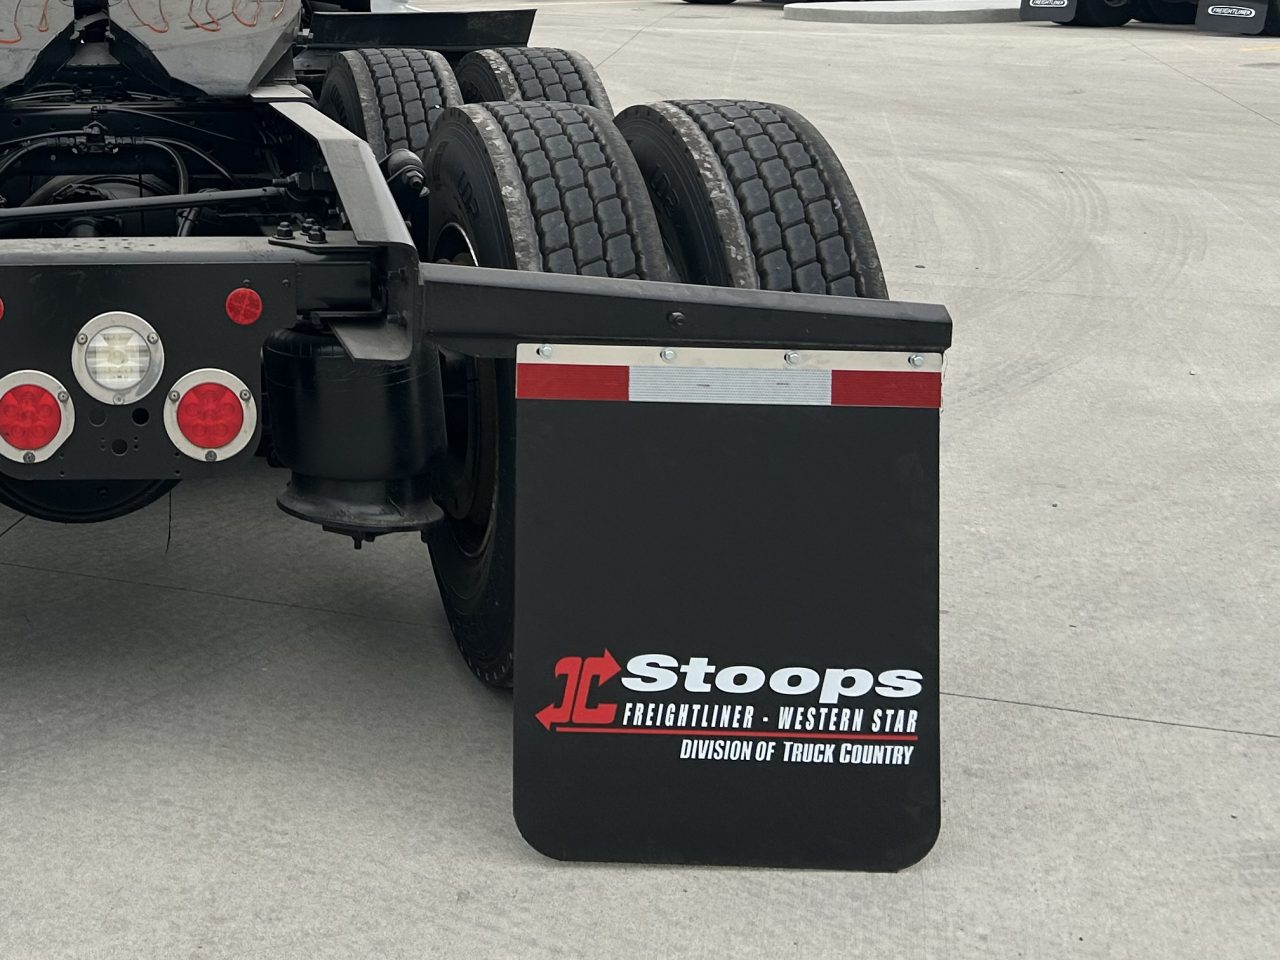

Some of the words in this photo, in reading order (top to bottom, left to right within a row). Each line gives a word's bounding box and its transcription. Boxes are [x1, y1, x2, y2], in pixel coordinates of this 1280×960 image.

[621, 653, 923, 705] Stoops
[622, 703, 754, 728] FREIGHTLINER
[778, 707, 863, 732] WESTERN
[871, 709, 919, 733] STAR
[680, 739, 751, 761] DIVISION
[754, 740, 777, 761] OF
[783, 742, 835, 763] TRUCK
[839, 743, 914, 765] COUNTRY
